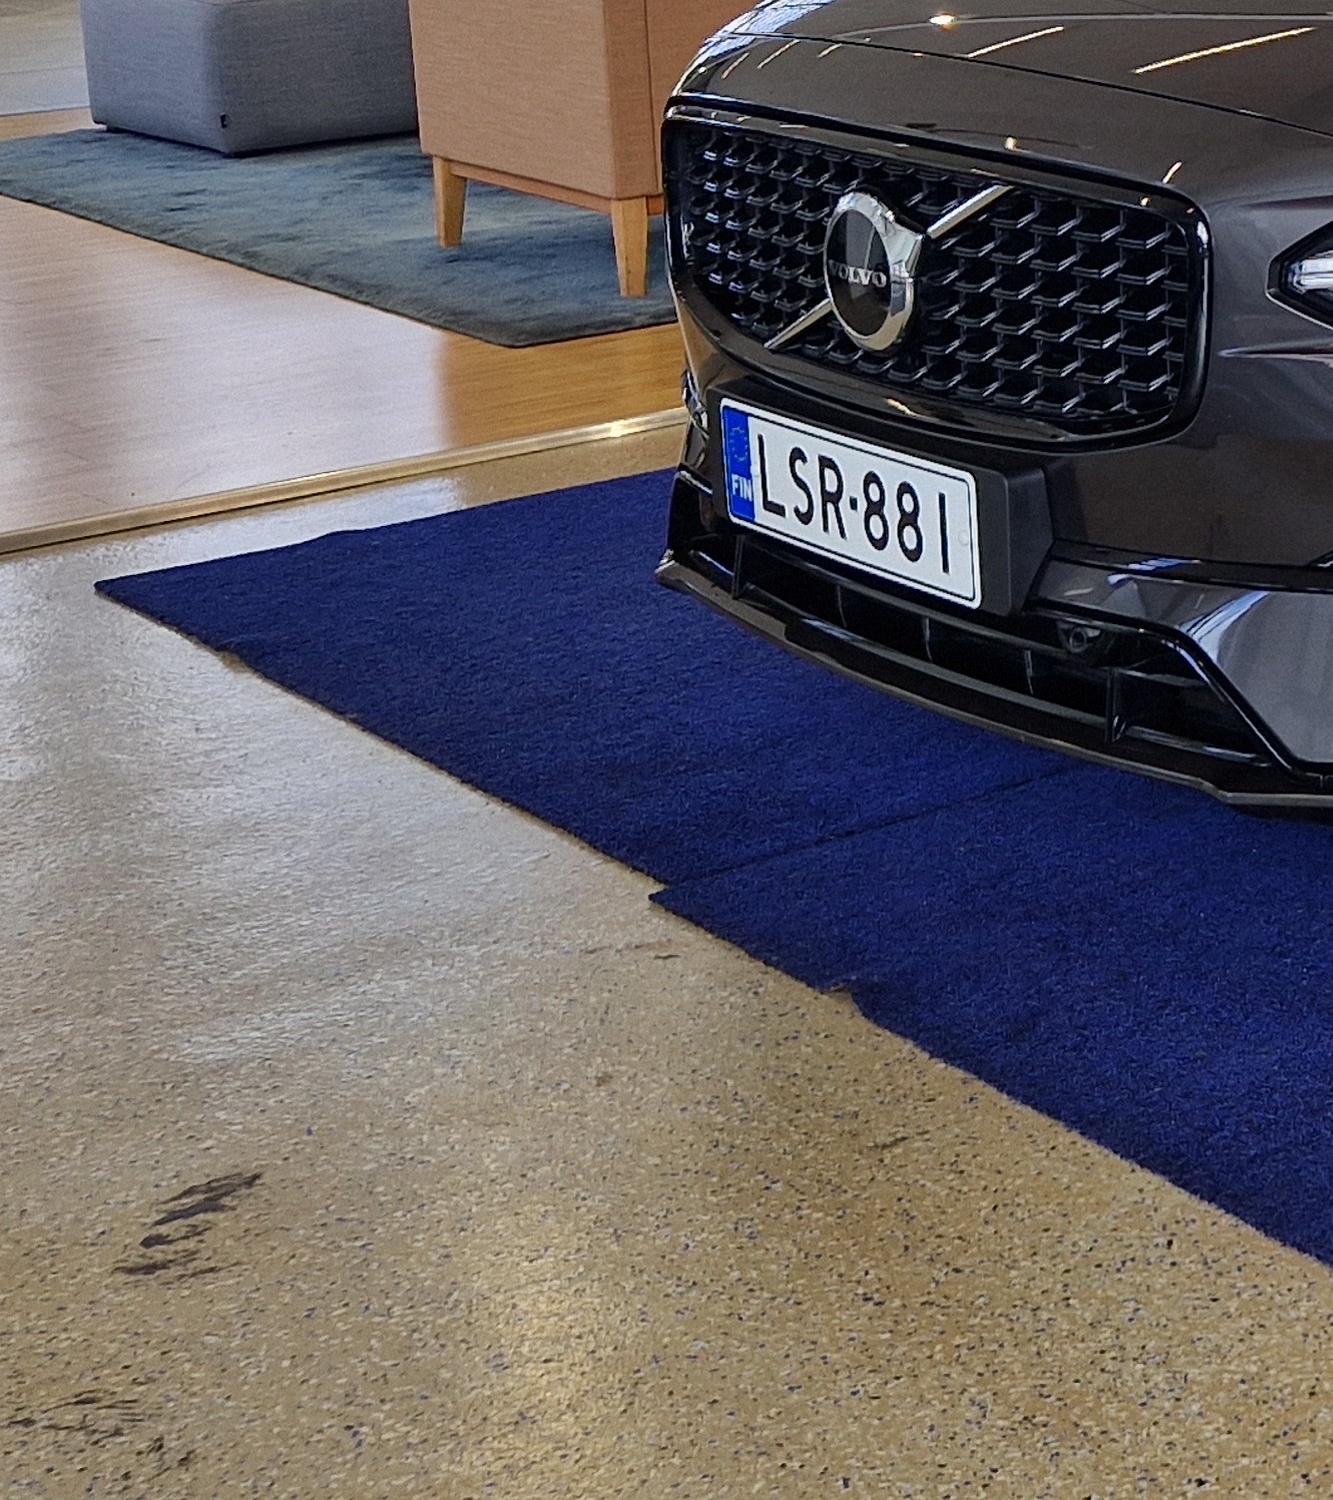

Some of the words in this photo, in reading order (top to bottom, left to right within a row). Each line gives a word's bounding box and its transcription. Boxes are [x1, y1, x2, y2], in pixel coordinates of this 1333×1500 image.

[828, 259, 887, 288] VOLVO
[731, 473, 753, 502] FIN
[757, 433, 950, 575] LSR-881
